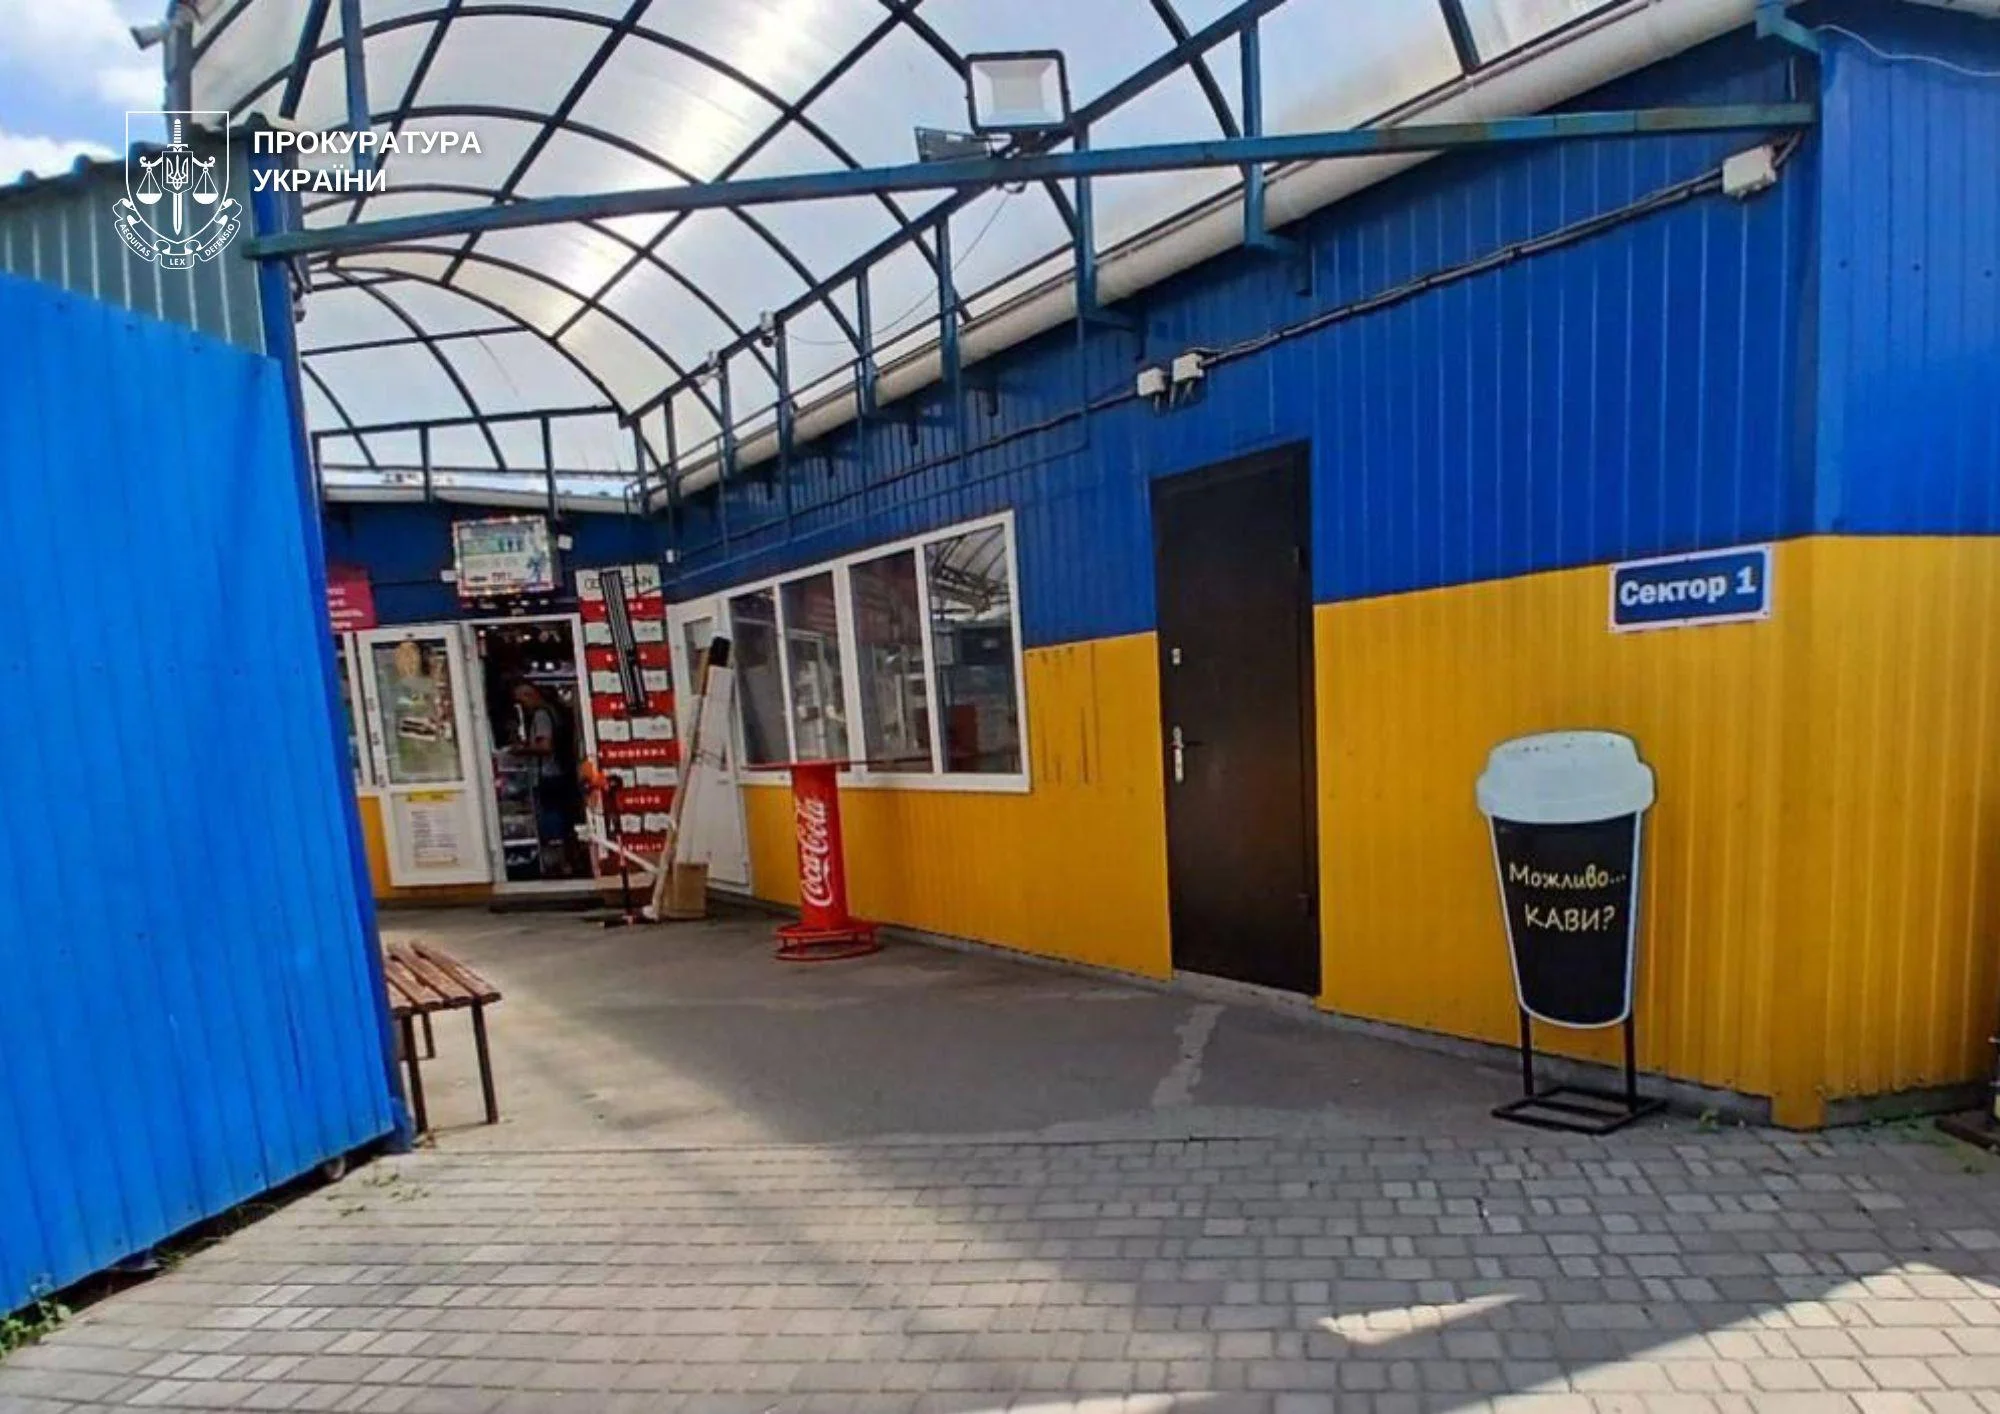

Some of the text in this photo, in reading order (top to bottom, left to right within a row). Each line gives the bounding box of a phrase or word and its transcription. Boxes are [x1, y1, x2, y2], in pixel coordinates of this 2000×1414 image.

[1619, 566, 1757, 606] Сектор 1
[796, 797, 832, 907] Coca-Cola
[1508, 862, 1626, 889] Можливо...
[1524, 903, 1616, 932] КАВИ?
